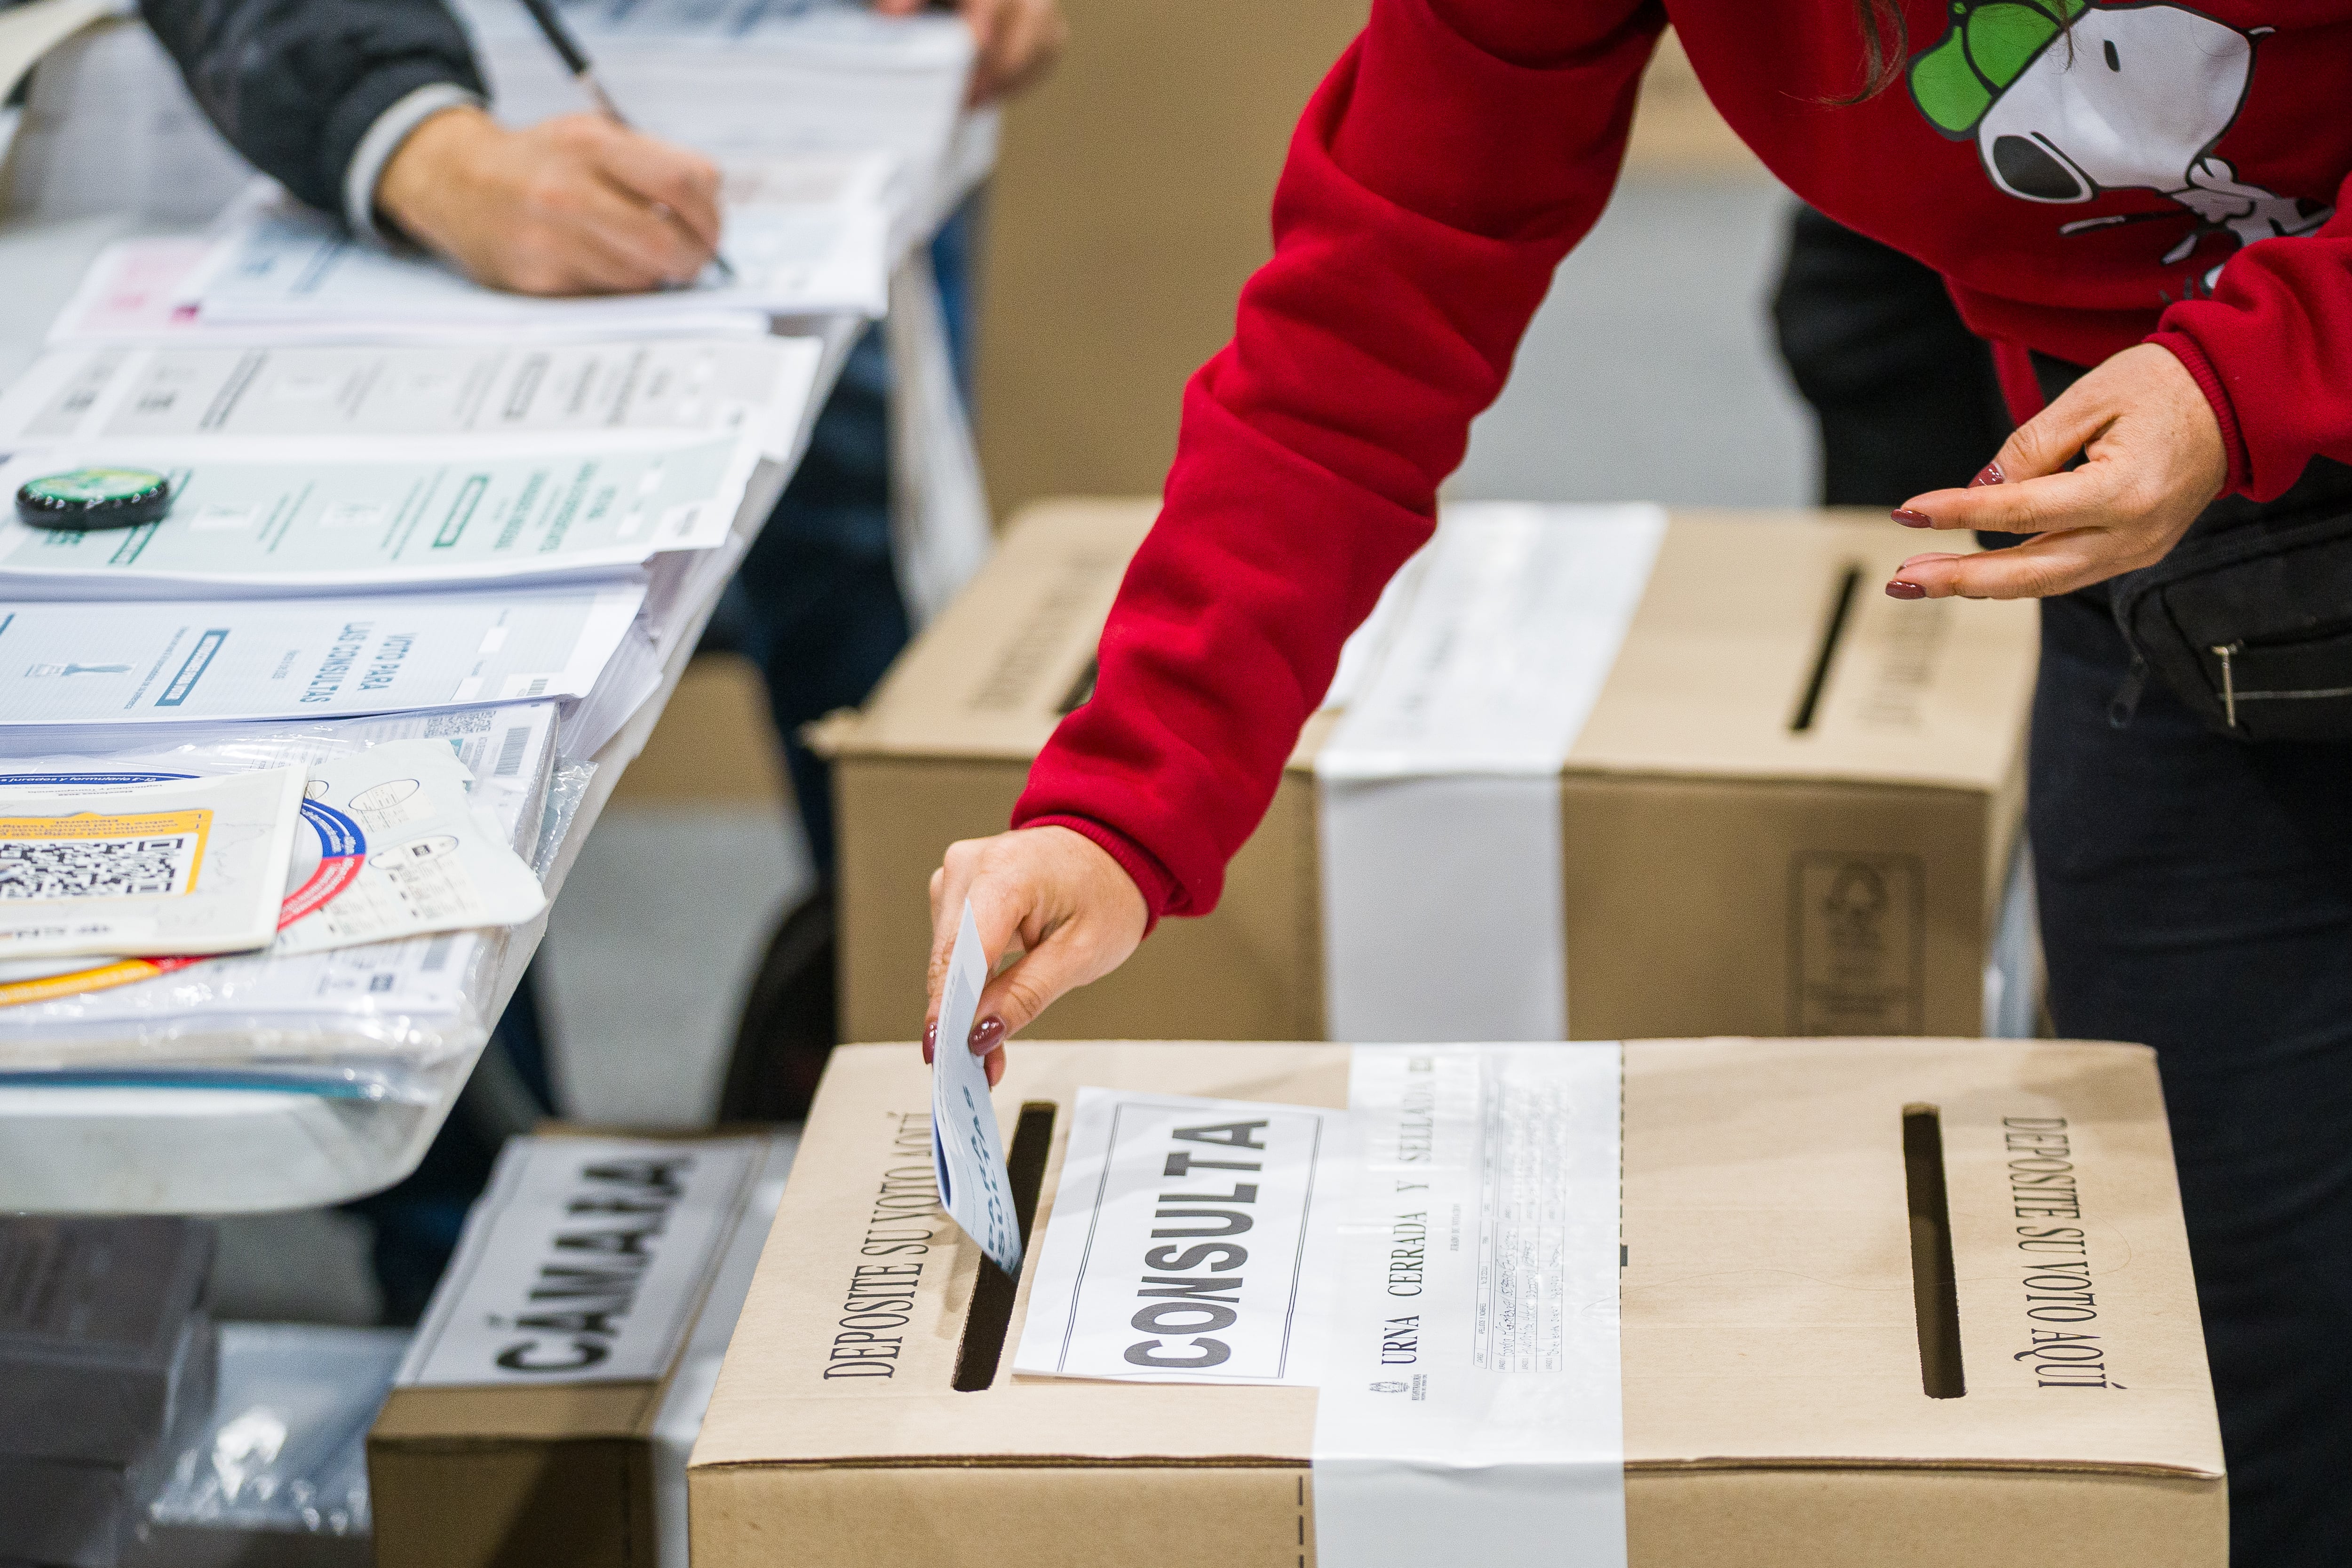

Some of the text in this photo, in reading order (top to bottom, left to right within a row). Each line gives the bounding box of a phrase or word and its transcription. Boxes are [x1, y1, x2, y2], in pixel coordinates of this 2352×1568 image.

[300, 621, 375, 702] LAS CONSULTAS
[357, 633, 419, 692] VOTO PARA
[871, 1164, 940, 1223] VOTO
[1396, 1179, 1430, 1194] Y
[485, 1156, 696, 1372] CÁMARA
[860, 1228, 934, 1256] SU
[1123, 1118, 1269, 1369] CONSULTA
[1388, 1210, 1428, 1297] CERRADA
[2002, 1116, 2128, 1390] DEPOSITE SU VOTO AQUÍ
[823, 1262, 924, 1380] DEPOSITE
[1381, 1314, 1420, 1365] URNA
